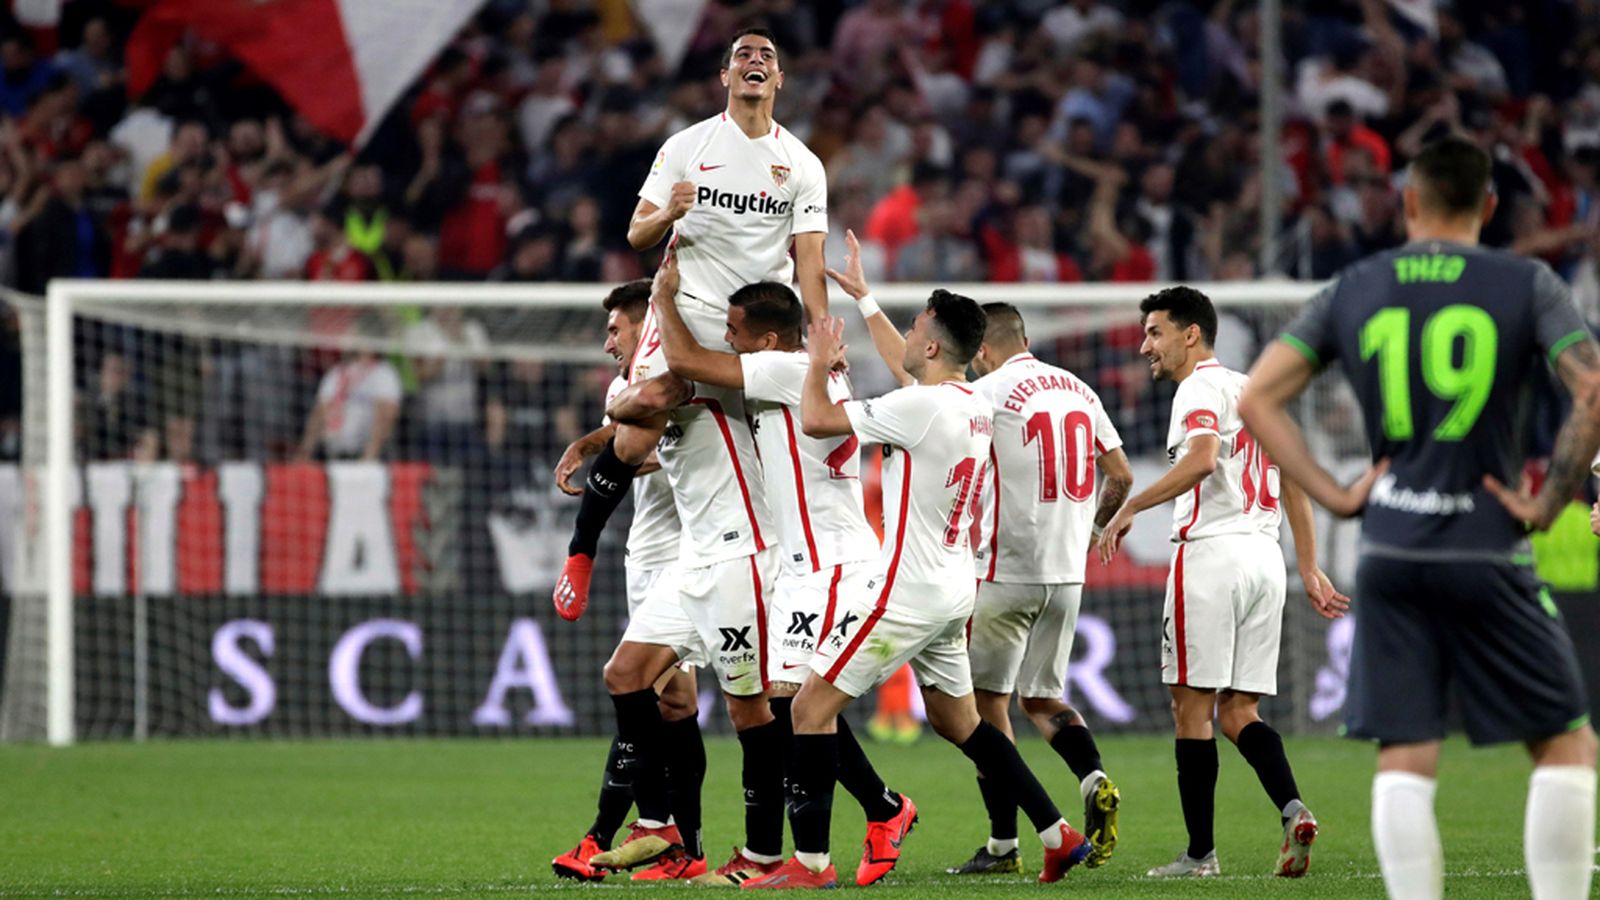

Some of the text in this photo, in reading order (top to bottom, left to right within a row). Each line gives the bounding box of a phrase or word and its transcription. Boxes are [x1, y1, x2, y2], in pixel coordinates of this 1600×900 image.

[697, 186, 790, 215] Playtika
[1394, 255, 1466, 284] THEO
[1359, 304, 1499, 442] 19
[1004, 378, 1040, 413] EVER
[1022, 410, 1096, 504] 10
[719, 651, 756, 665] everfx
